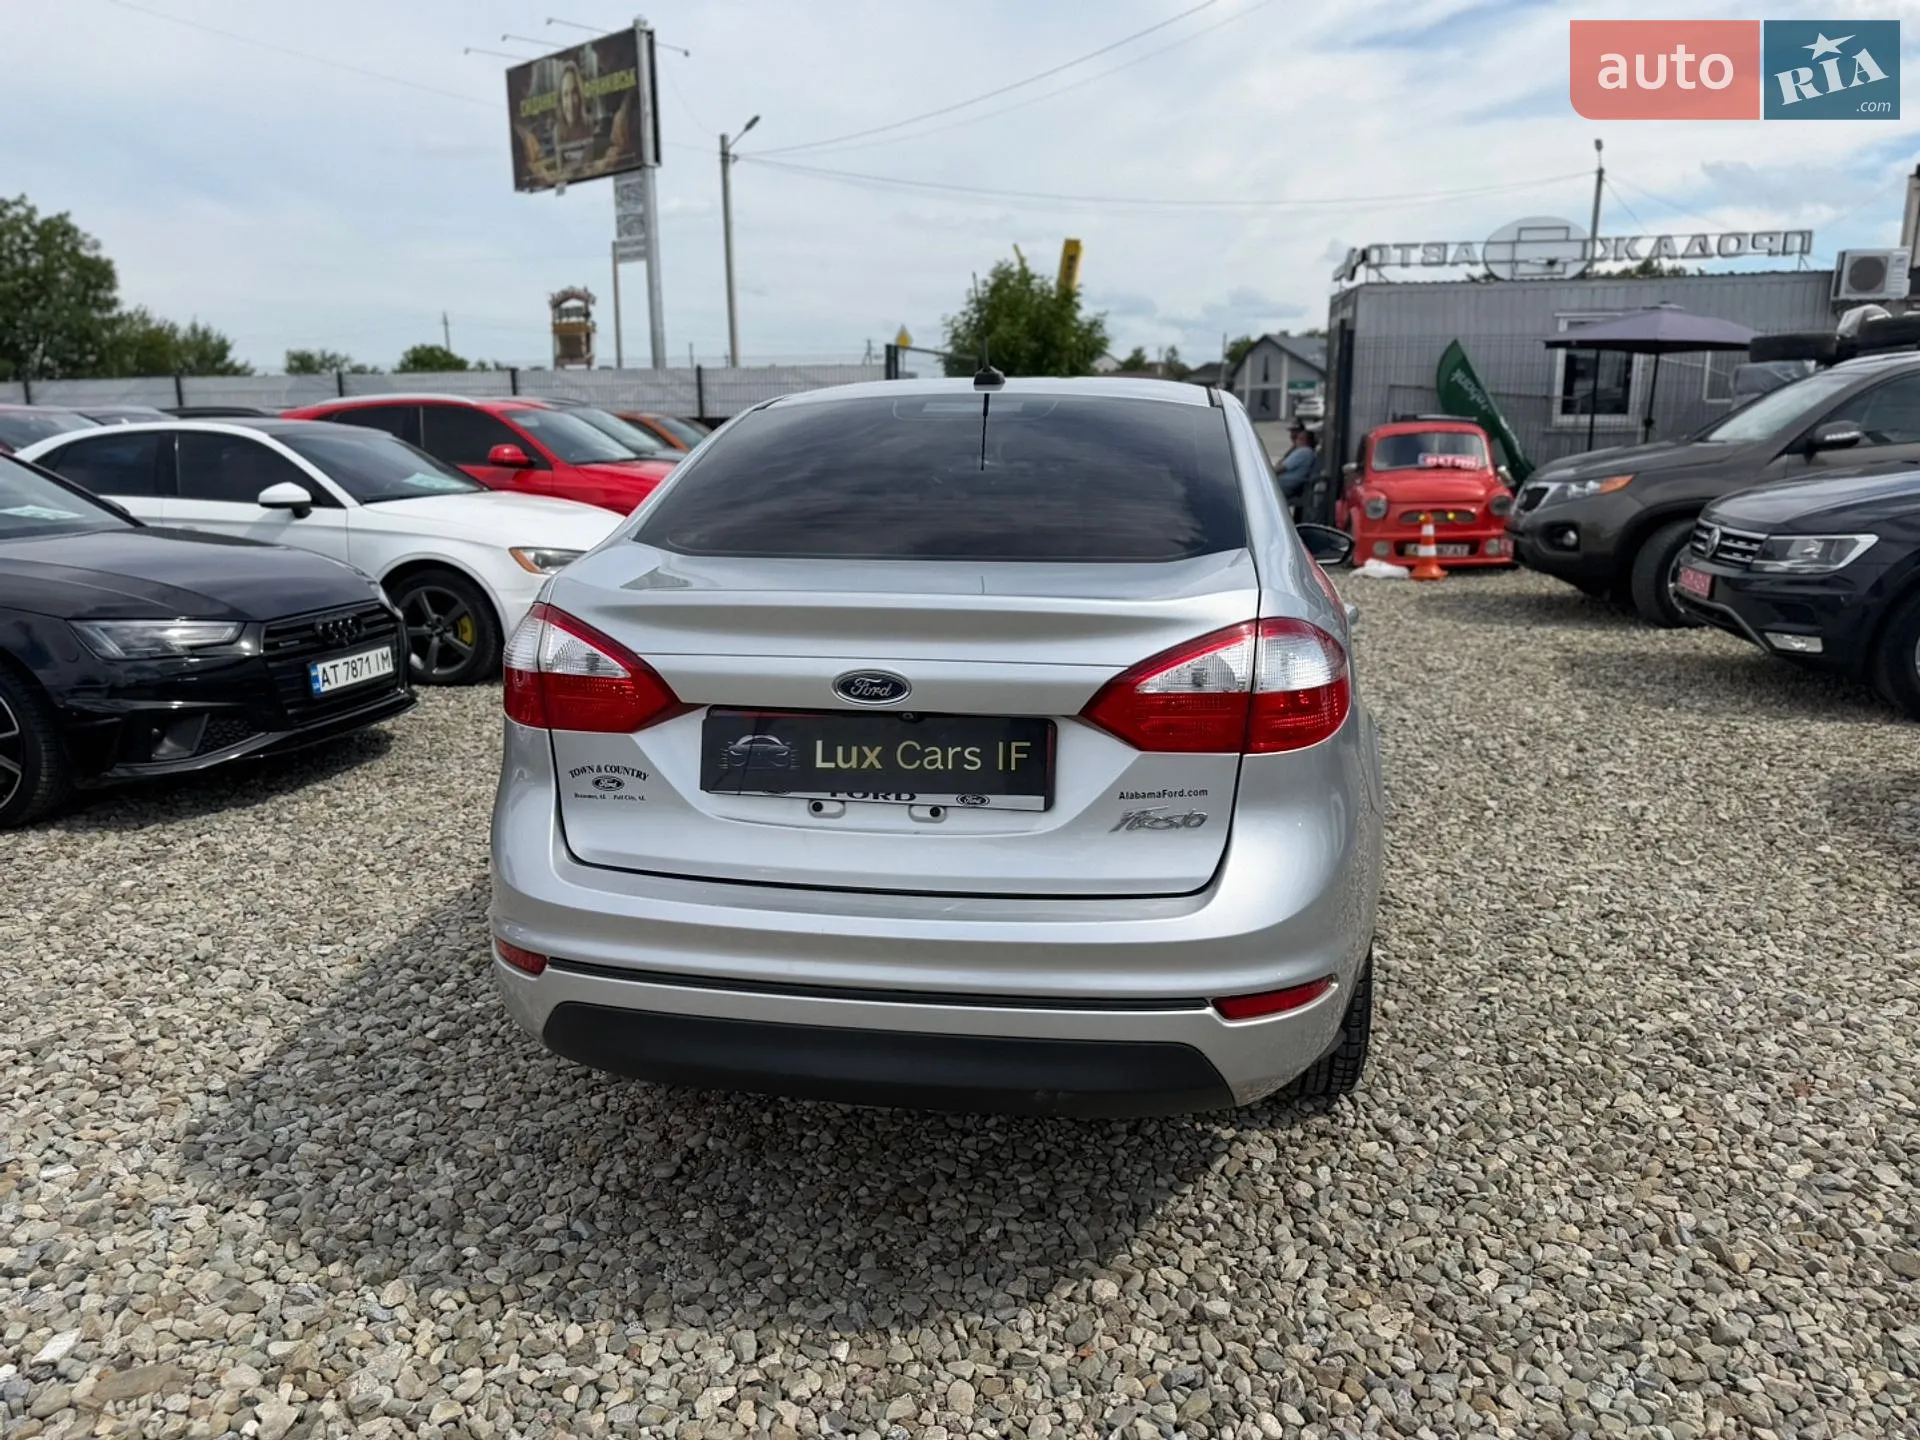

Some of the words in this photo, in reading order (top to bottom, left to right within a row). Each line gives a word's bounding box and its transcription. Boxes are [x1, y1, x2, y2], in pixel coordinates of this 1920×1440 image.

[321, 664, 339, 688] AT
[343, 656, 372, 681] 7871
[377, 651, 393, 672] IM
[850, 677, 893, 697] Ford
[815, 740, 883, 769] Lux
[896, 740, 982, 771] Cars
[998, 741, 1031, 771] IF
[569, 765, 595, 779] TOWN
[596, 764, 603, 773] &
[604, 764, 649, 781] COUNTRY
[1118, 789, 1208, 800] AlabamaFord.com
